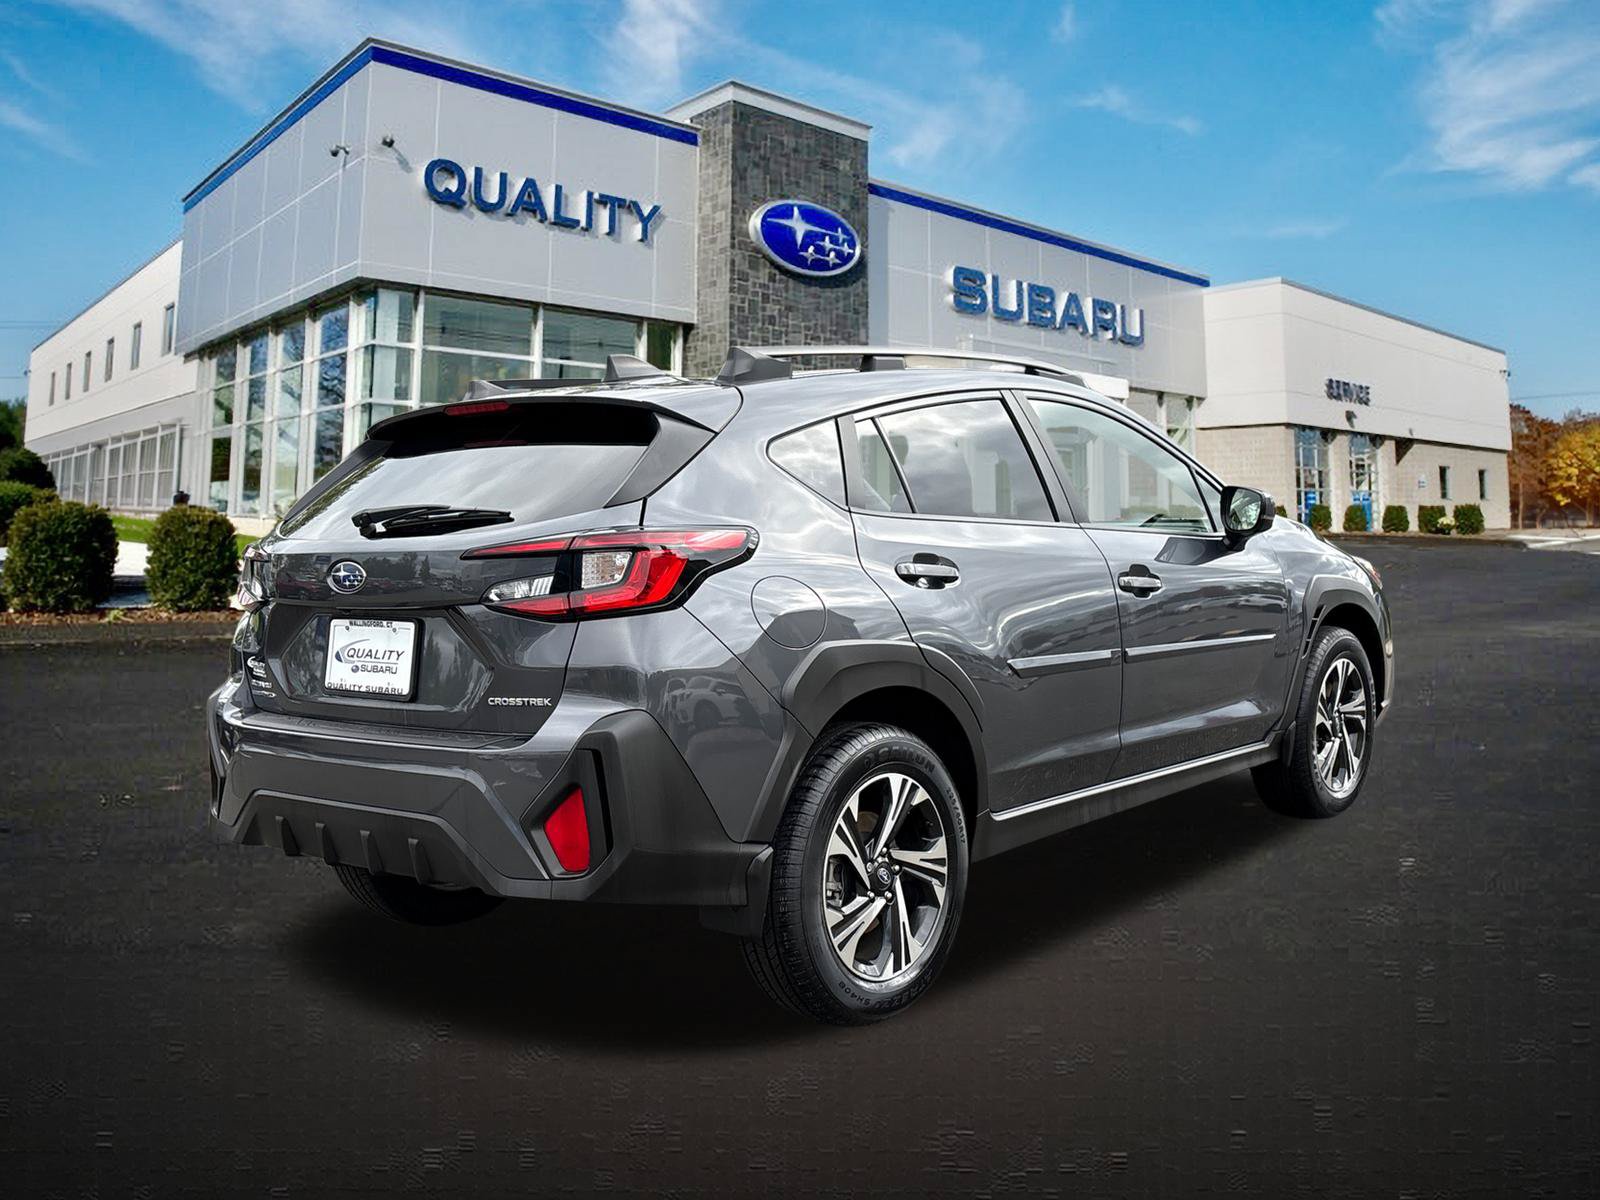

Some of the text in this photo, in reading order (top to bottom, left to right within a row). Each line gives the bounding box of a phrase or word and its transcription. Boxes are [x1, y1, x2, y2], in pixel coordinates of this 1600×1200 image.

[422, 158, 662, 242] QUALITY
[948, 265, 1144, 346] SUBARU
[1325, 378, 1371, 406] SERVICE
[346, 647, 405, 661] QUALITY
[360, 664, 398, 675] SUBARU
[327, 682, 404, 695] QUALITY SUBARU
[487, 697, 552, 706] CROSSTREK
